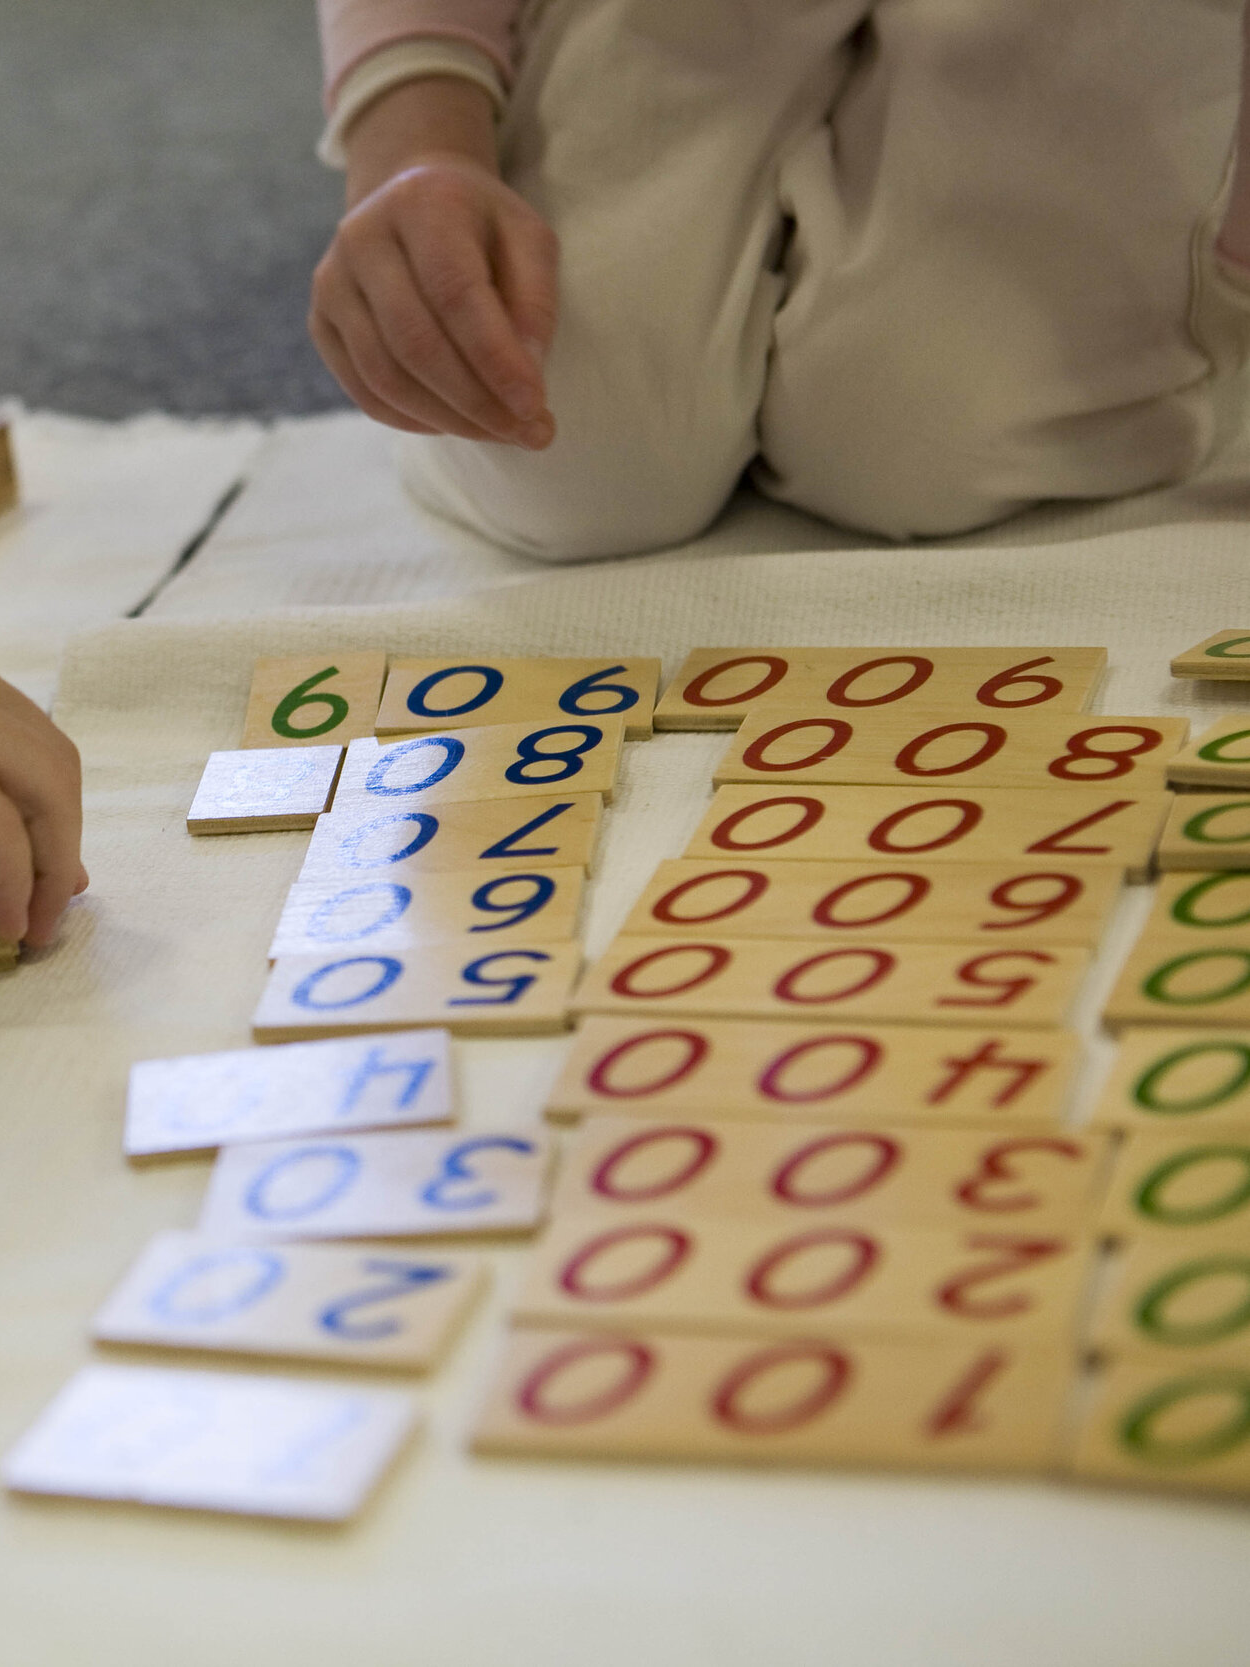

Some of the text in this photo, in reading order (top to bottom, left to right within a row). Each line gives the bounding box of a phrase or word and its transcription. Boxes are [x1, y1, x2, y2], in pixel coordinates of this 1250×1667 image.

[365, 724, 603, 797] 80
[743, 718, 1162, 780] 800
[341, 803, 576, 870] 70
[711, 796, 1138, 855] 700
[307, 874, 556, 943] 60
[652, 869, 1084, 930] 600
[291, 950, 552, 1011] 50
[610, 944, 1058, 1007] 500
[586, 1029, 1054, 1108] 400
[243, 1135, 536, 1222] 30
[589, 1126, 1086, 1213] 300
[146, 1249, 458, 1341] 20
[559, 1224, 1070, 1320] 200
[514, 1335, 1012, 1440] 100
